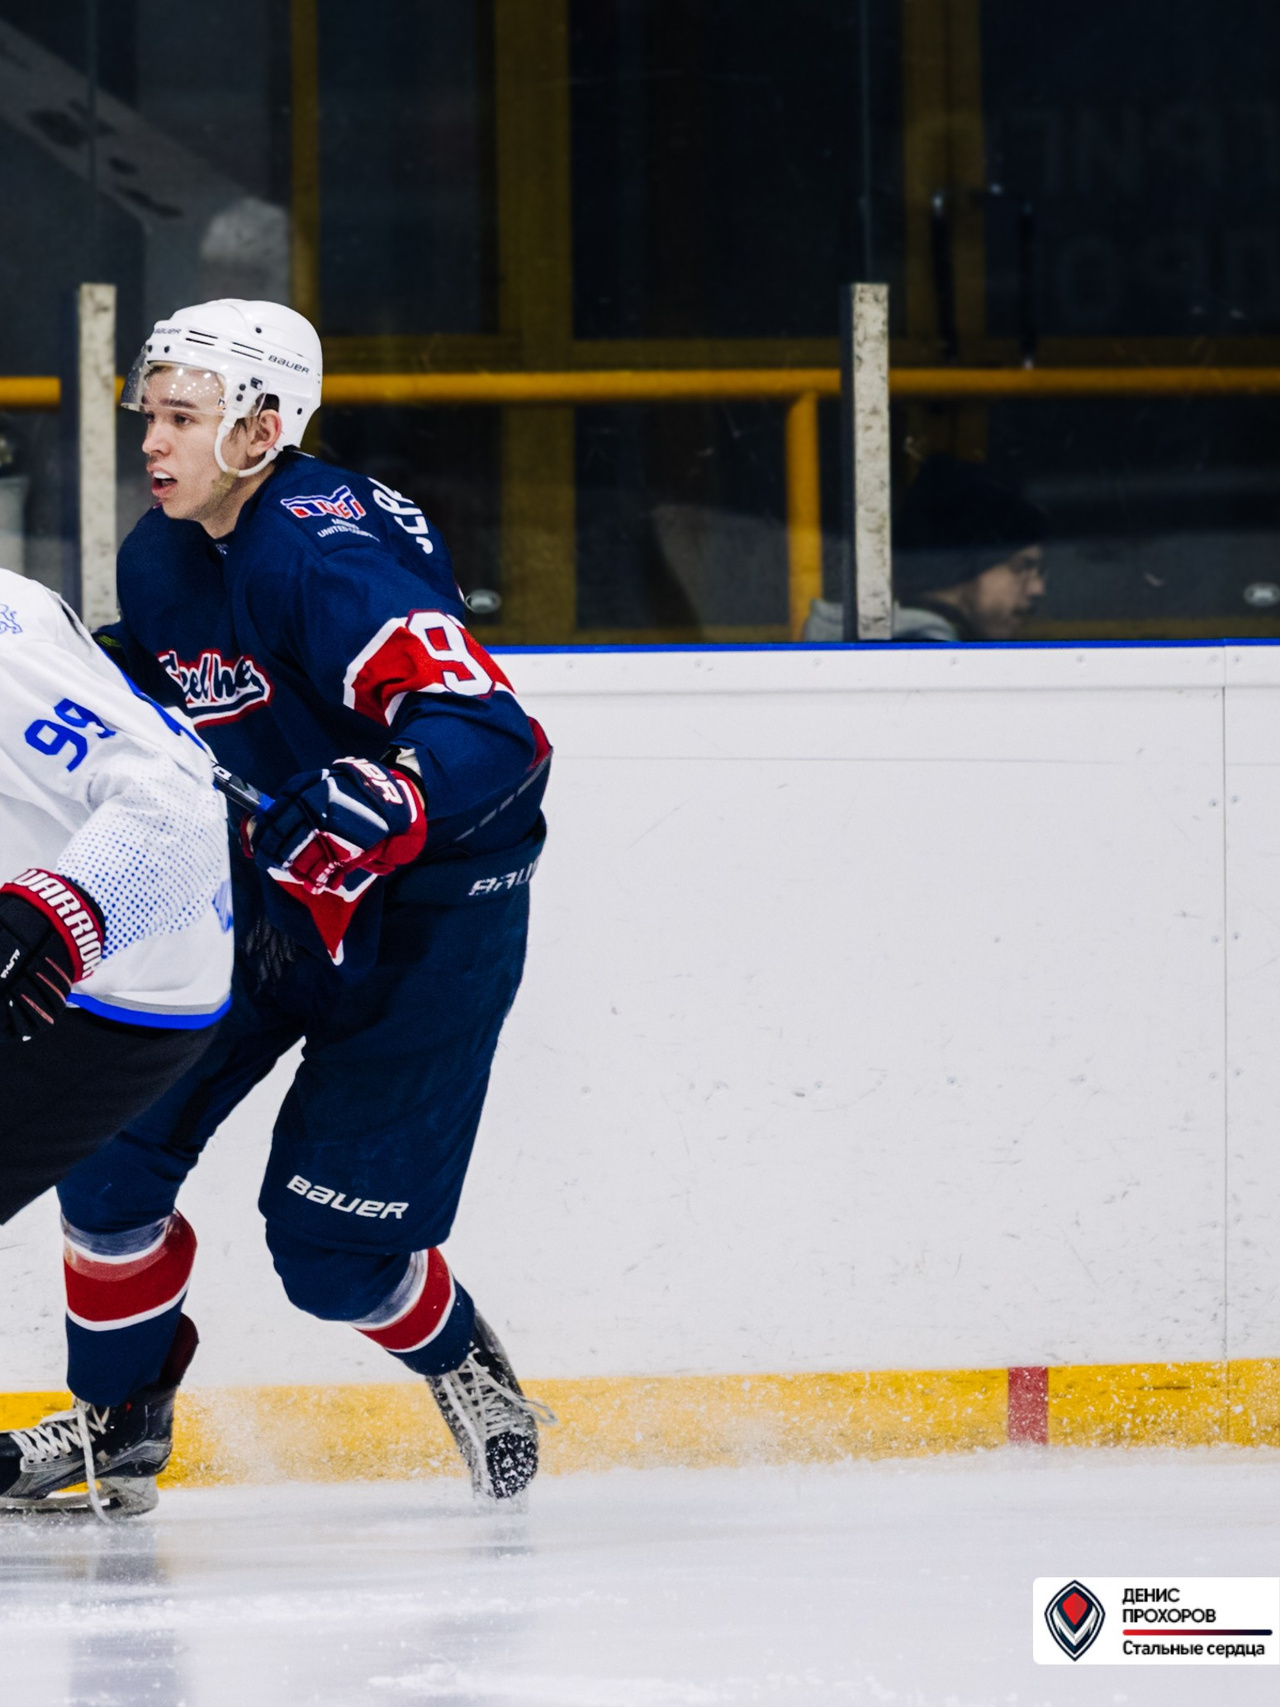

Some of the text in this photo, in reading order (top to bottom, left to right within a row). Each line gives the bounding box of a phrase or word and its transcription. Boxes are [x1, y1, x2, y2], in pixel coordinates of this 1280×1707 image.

[268, 354, 310, 375] BAUER
[24, 697, 117, 773] 99
[286, 1174, 409, 1220] BAUER
